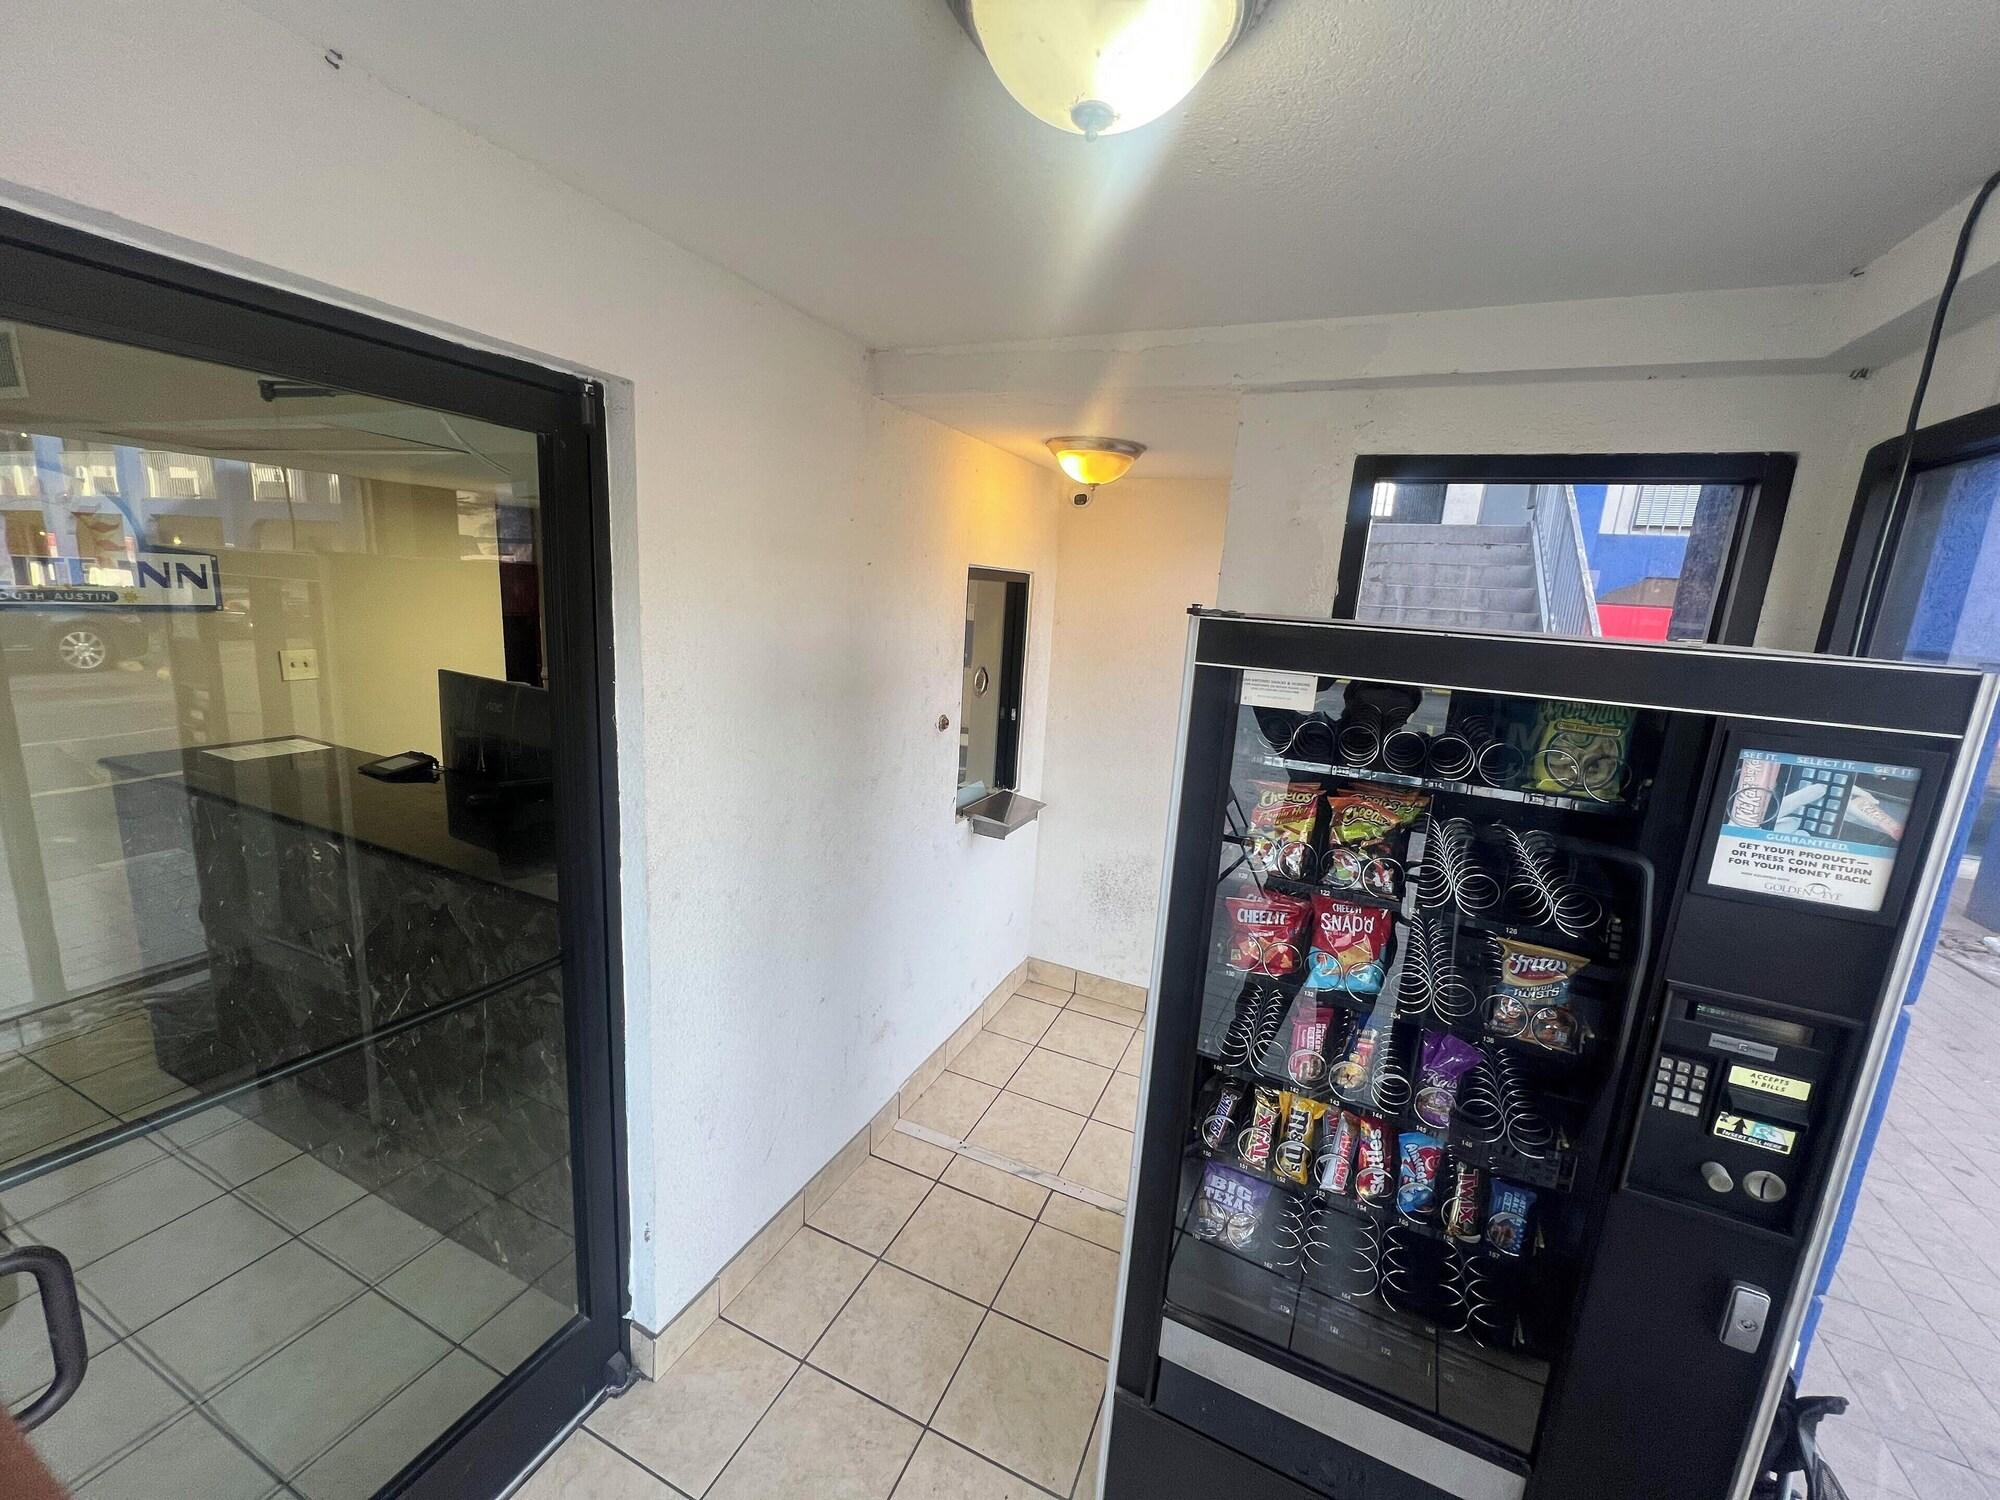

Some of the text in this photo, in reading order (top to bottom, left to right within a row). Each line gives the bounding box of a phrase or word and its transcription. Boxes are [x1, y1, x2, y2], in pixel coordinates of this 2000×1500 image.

[53, 592, 111, 601] AUSTIN
[1743, 752, 1763, 760] SEE
[1797, 757, 1856, 770] SELECT IT.
[1874, 766, 1898, 775] GET
[1258, 789, 1317, 809] Cheetos
[1738, 841, 1760, 850] GET
[1764, 846, 1795, 856] YOUR
[1766, 832, 1848, 850] GUARANTEED.
[1731, 849, 1873, 876] OR PRESS COIN RETURN
[1728, 857, 1750, 866] FOR
[1753, 861, 1785, 872] YOUR
[1788, 866, 1831, 879] MONEY
[1835, 873, 1872, 886] BACK.
[1750, 1071, 1790, 1086] ACCEPTS
[1760, 1081, 1786, 1093] BILLS
[1250, 1113, 1273, 1161] TWIX
[1721, 1129, 1748, 1142] INSERT
[1210, 1174, 1253, 1202] BIG
[1457, 1168, 1479, 1224] TWIX
[1203, 1186, 1254, 1214] TEXAS
